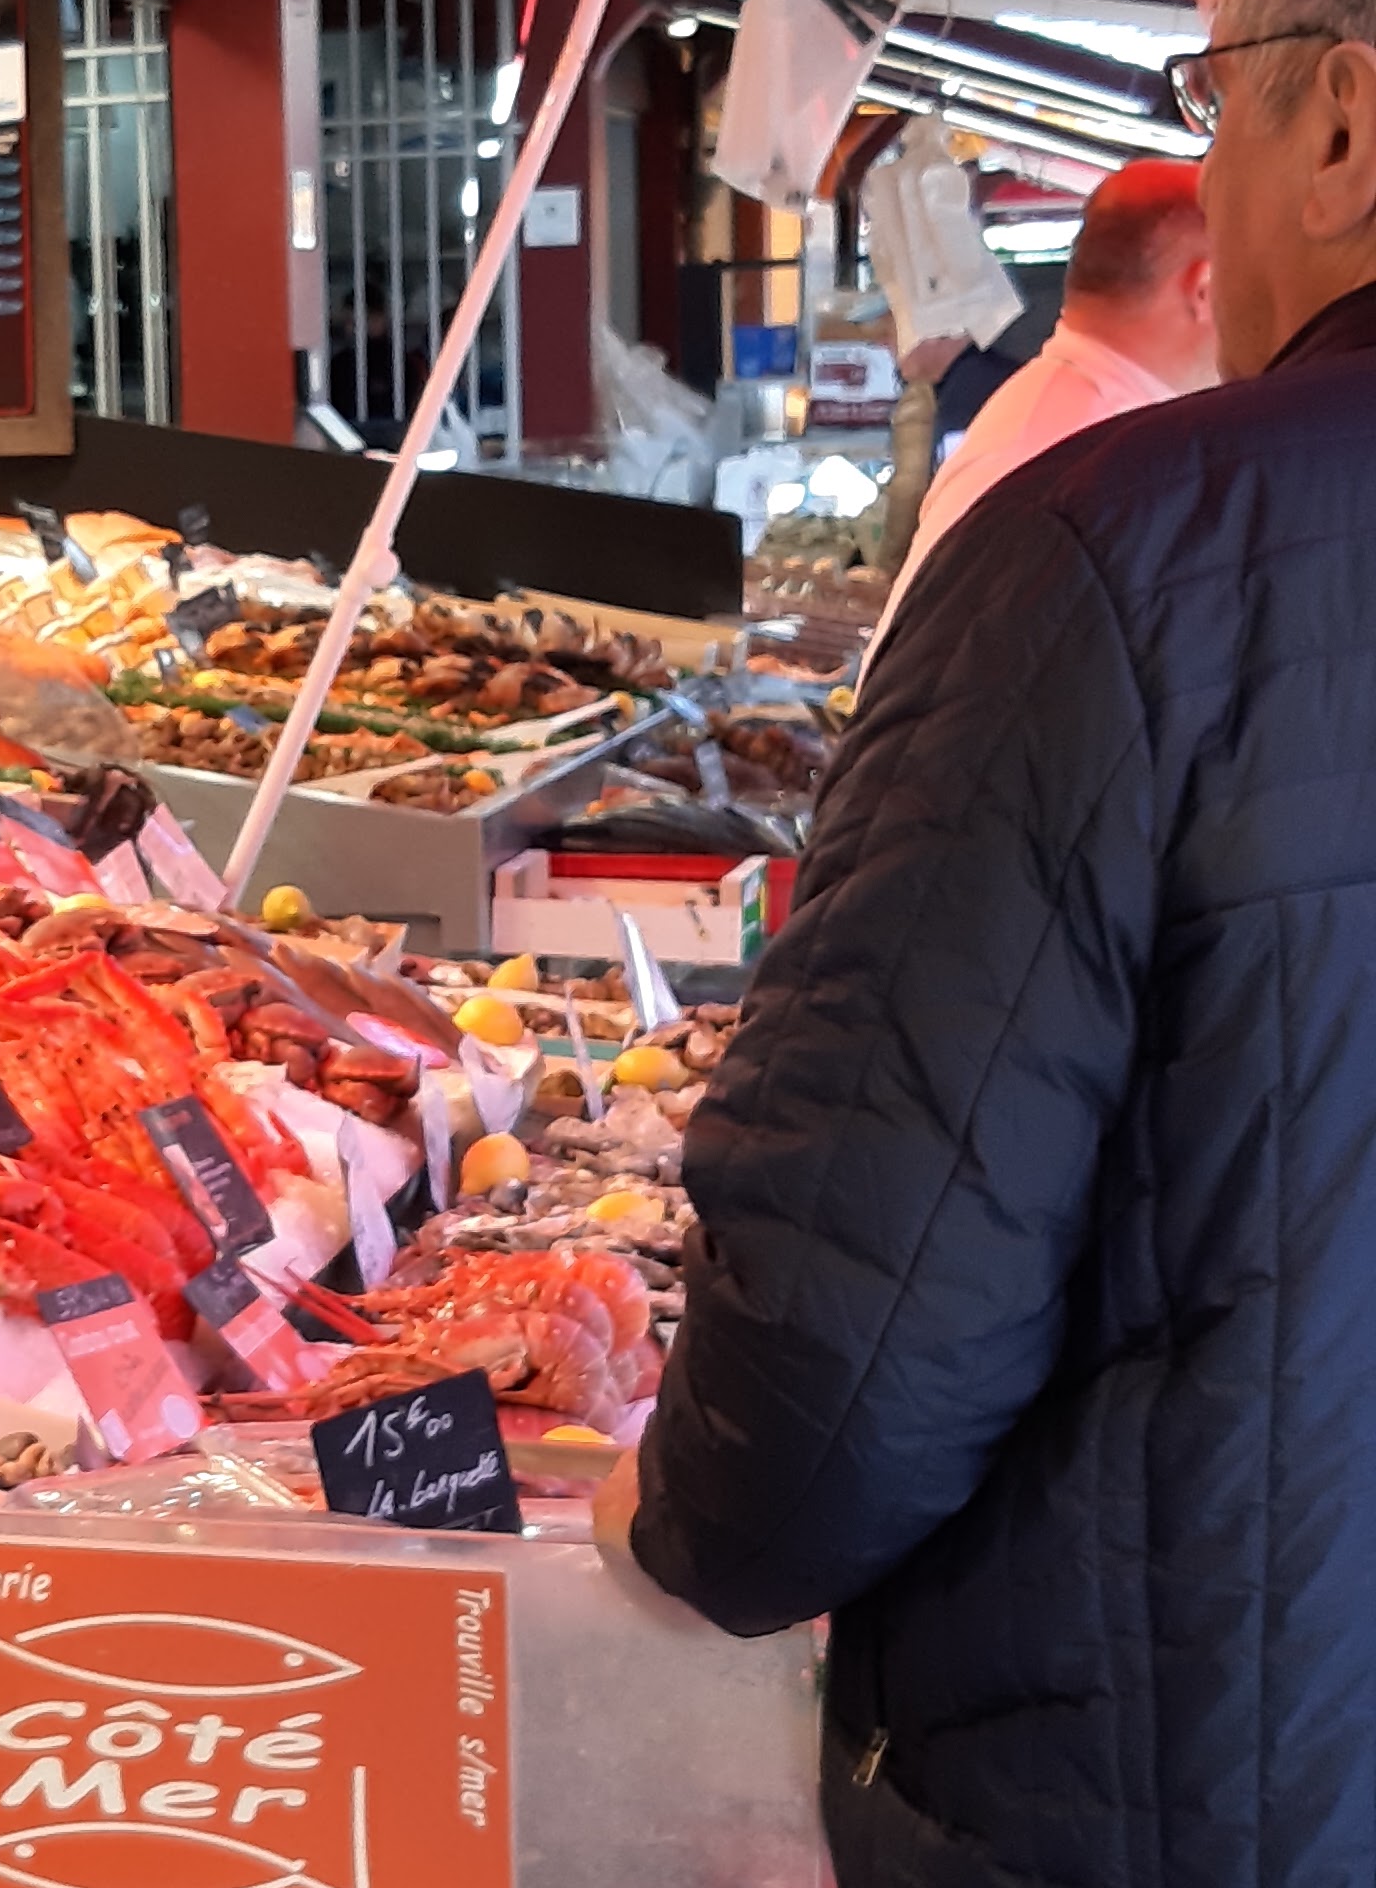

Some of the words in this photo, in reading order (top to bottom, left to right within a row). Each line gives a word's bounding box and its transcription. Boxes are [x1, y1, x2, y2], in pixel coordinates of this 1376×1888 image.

[456, 1587, 494, 1715] Trouville
[0, 1755, 307, 1824] Mer
[459, 1733, 499, 1828] s/mer
